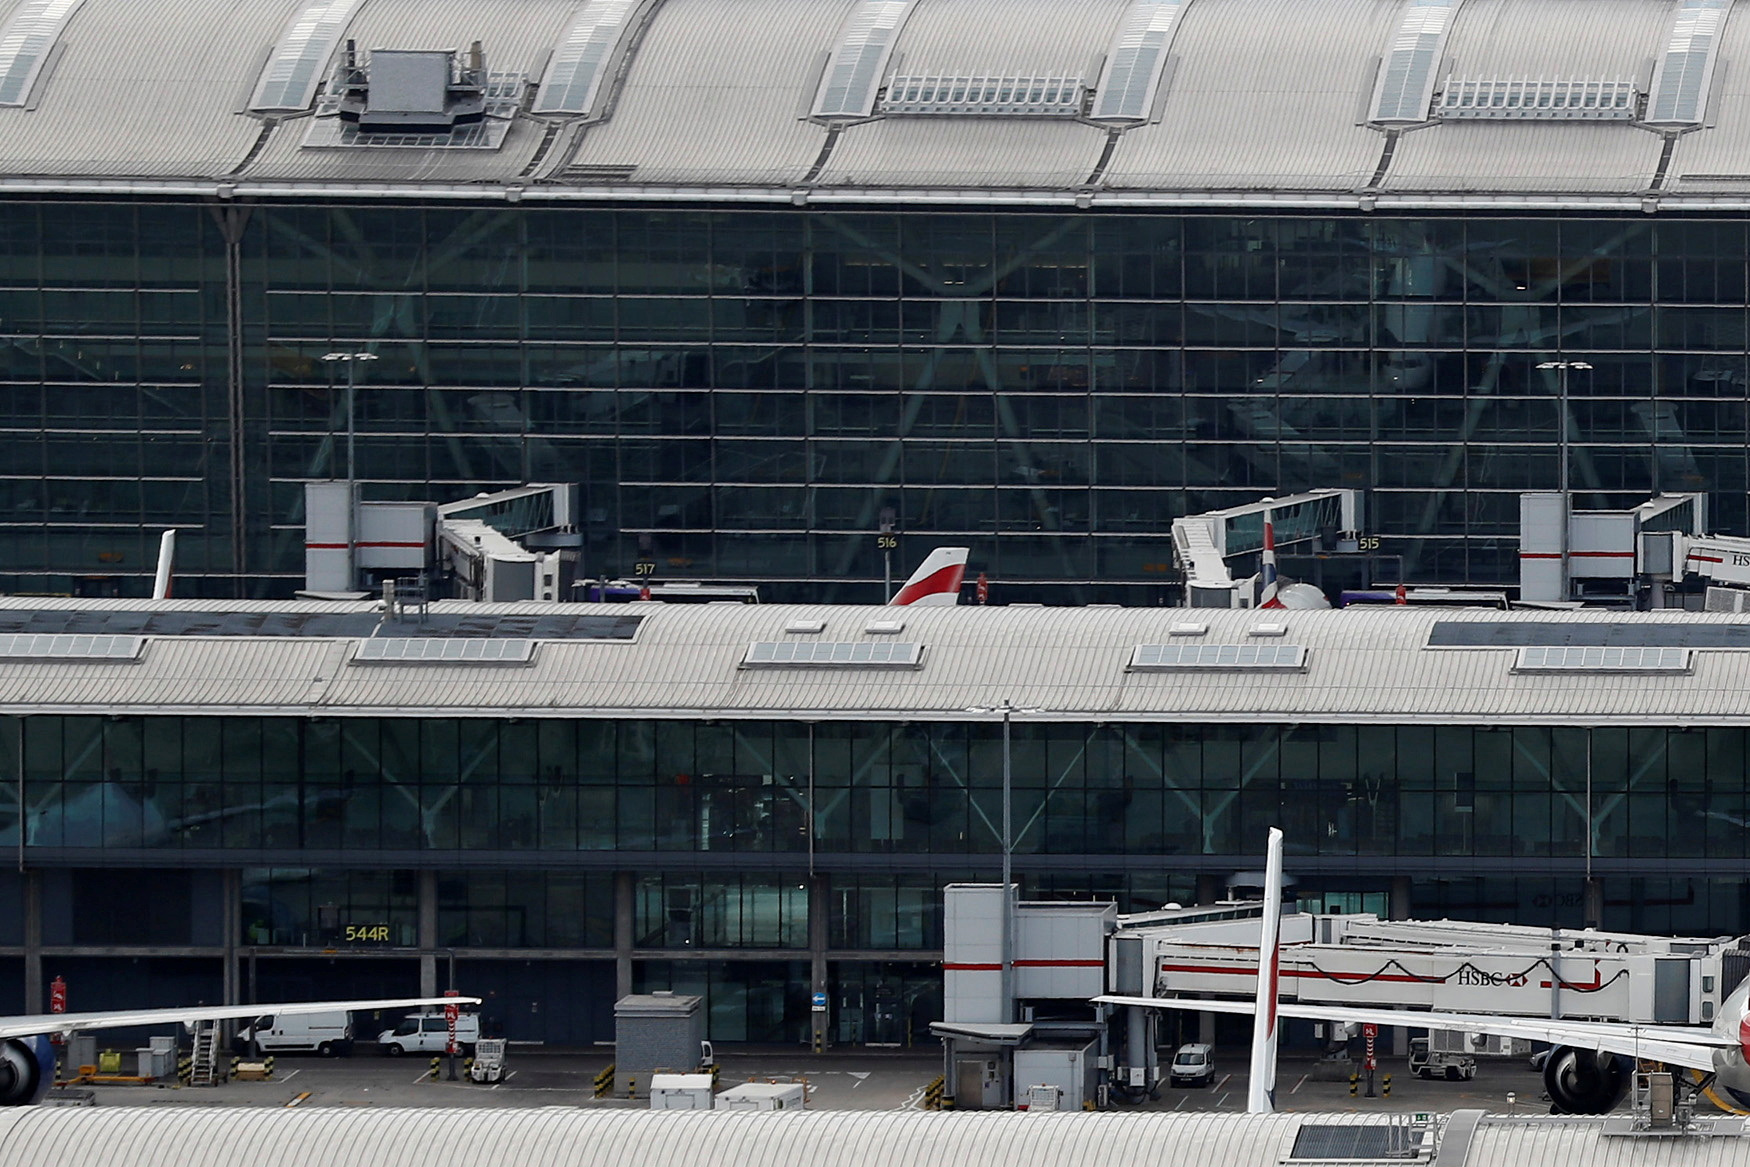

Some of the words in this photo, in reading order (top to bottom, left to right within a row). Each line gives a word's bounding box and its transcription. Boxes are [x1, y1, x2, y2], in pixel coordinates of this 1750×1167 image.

[877, 536, 897, 548] 516
[1359, 537, 1380, 549] 515
[635, 563, 656, 575] 517
[345, 926, 389, 941] 544R
[1458, 970, 1503, 986] HSBC
